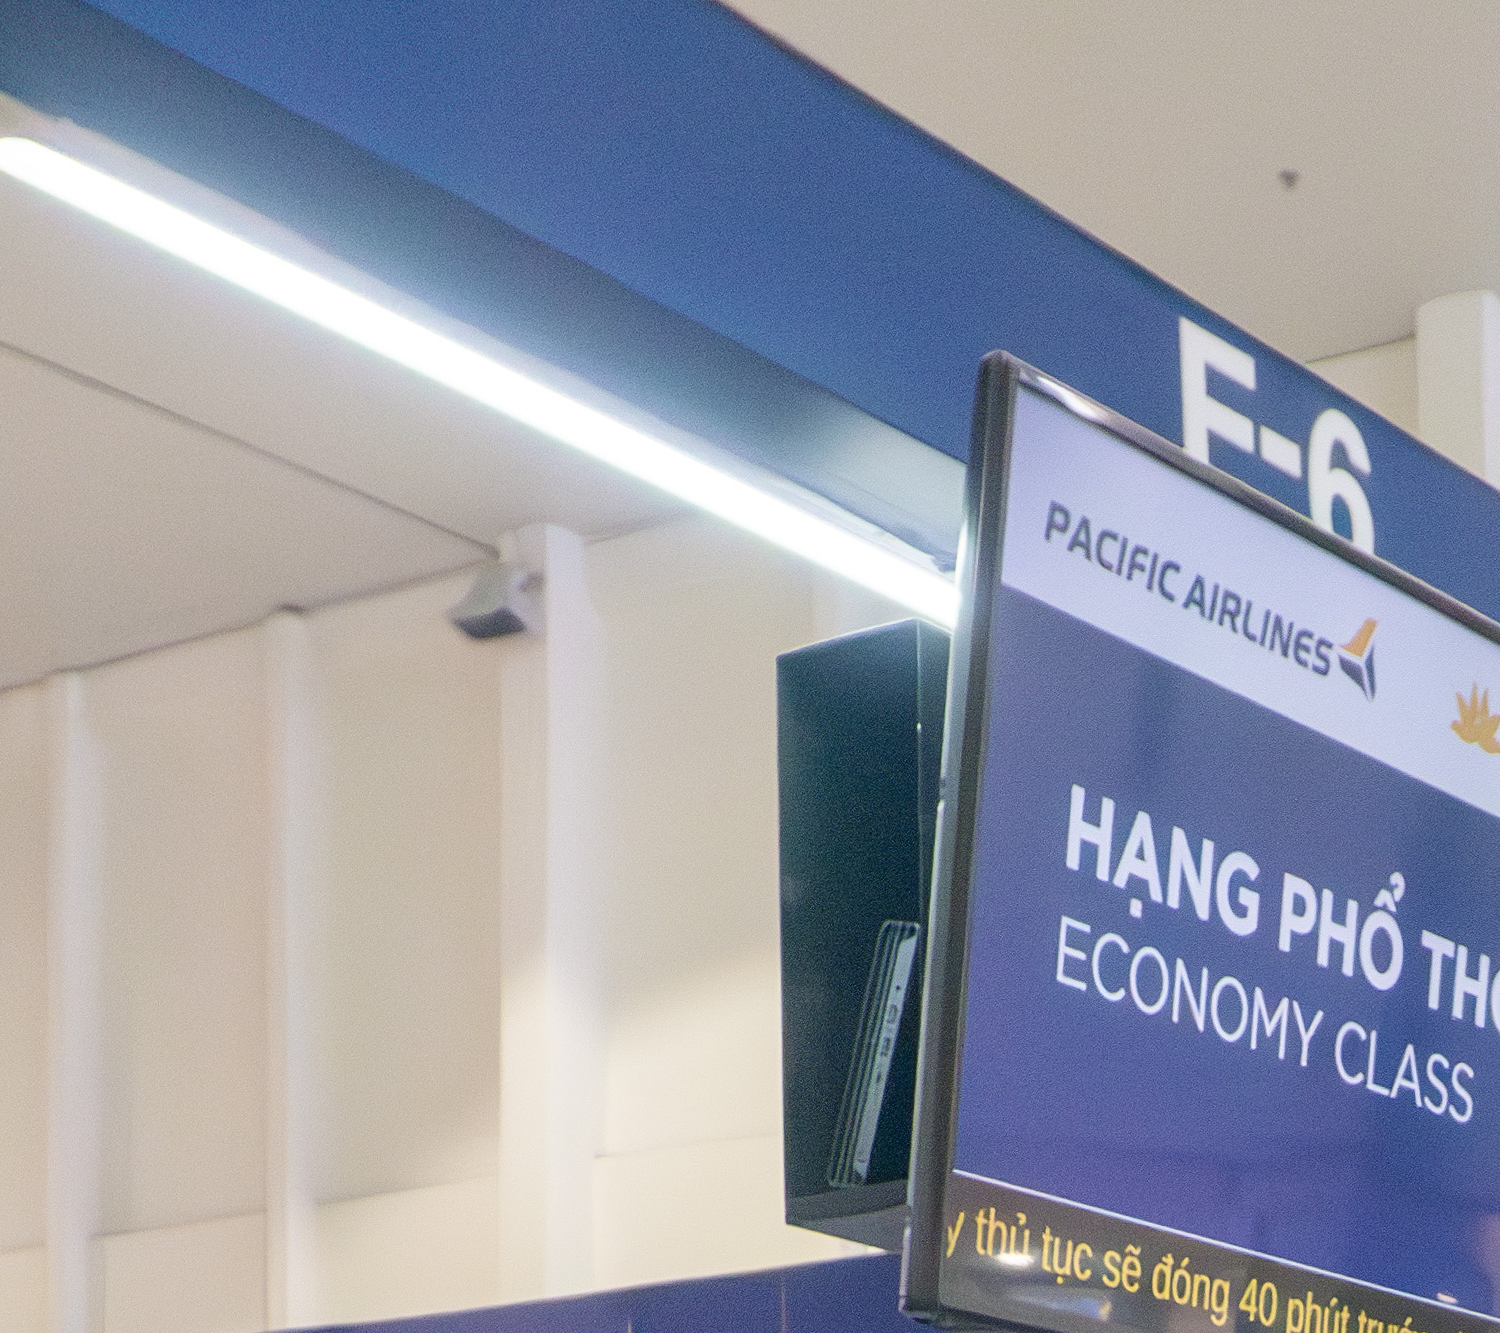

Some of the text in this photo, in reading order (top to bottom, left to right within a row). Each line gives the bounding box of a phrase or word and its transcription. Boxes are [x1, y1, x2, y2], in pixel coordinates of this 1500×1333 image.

[1044, 500, 1332, 677] PACIFIC AIRLINES
[1065, 784, 1260, 938] HẠNG
[1278, 871, 1406, 992] PHỔ
[1055, 915, 1476, 1124] ECONOMY CLASS
[974, 1205, 1033, 1261] thủ
[1040, 1224, 1092, 1286] tục
[1102, 1238, 1141, 1295] sẽ
[1151, 1253, 1229, 1327] đóng
[1239, 1280, 1279, 1328] 40
